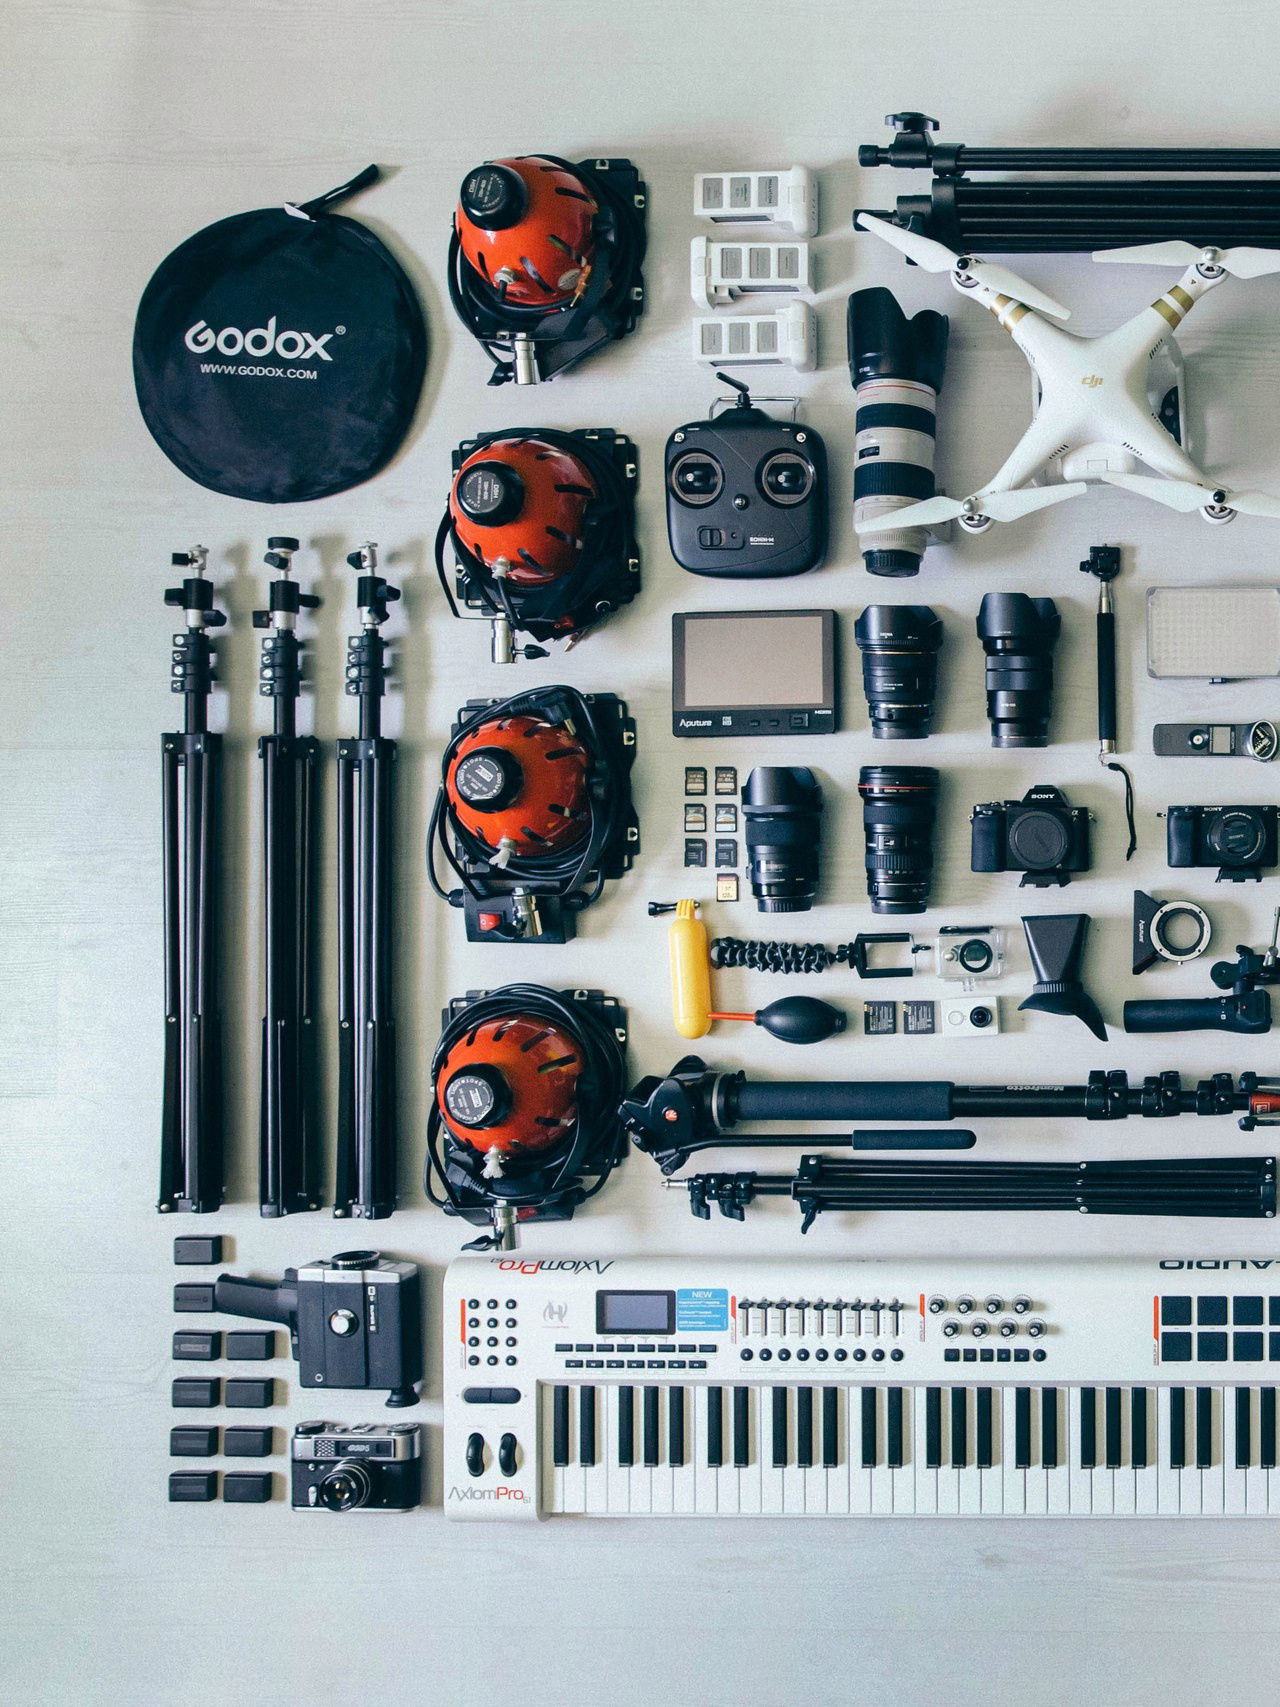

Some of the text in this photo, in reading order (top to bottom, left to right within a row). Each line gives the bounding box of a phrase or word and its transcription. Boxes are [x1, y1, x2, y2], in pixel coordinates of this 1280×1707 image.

[185, 316, 334, 361] Godox
[200, 363, 318, 380] WWW.GODOX.COM
[1082, 374, 1104, 388] dji
[679, 719, 712, 728] Aputure
[499, 1260, 614, 1275] AxiomPro
[448, 1486, 524, 1501] AxiomPro
